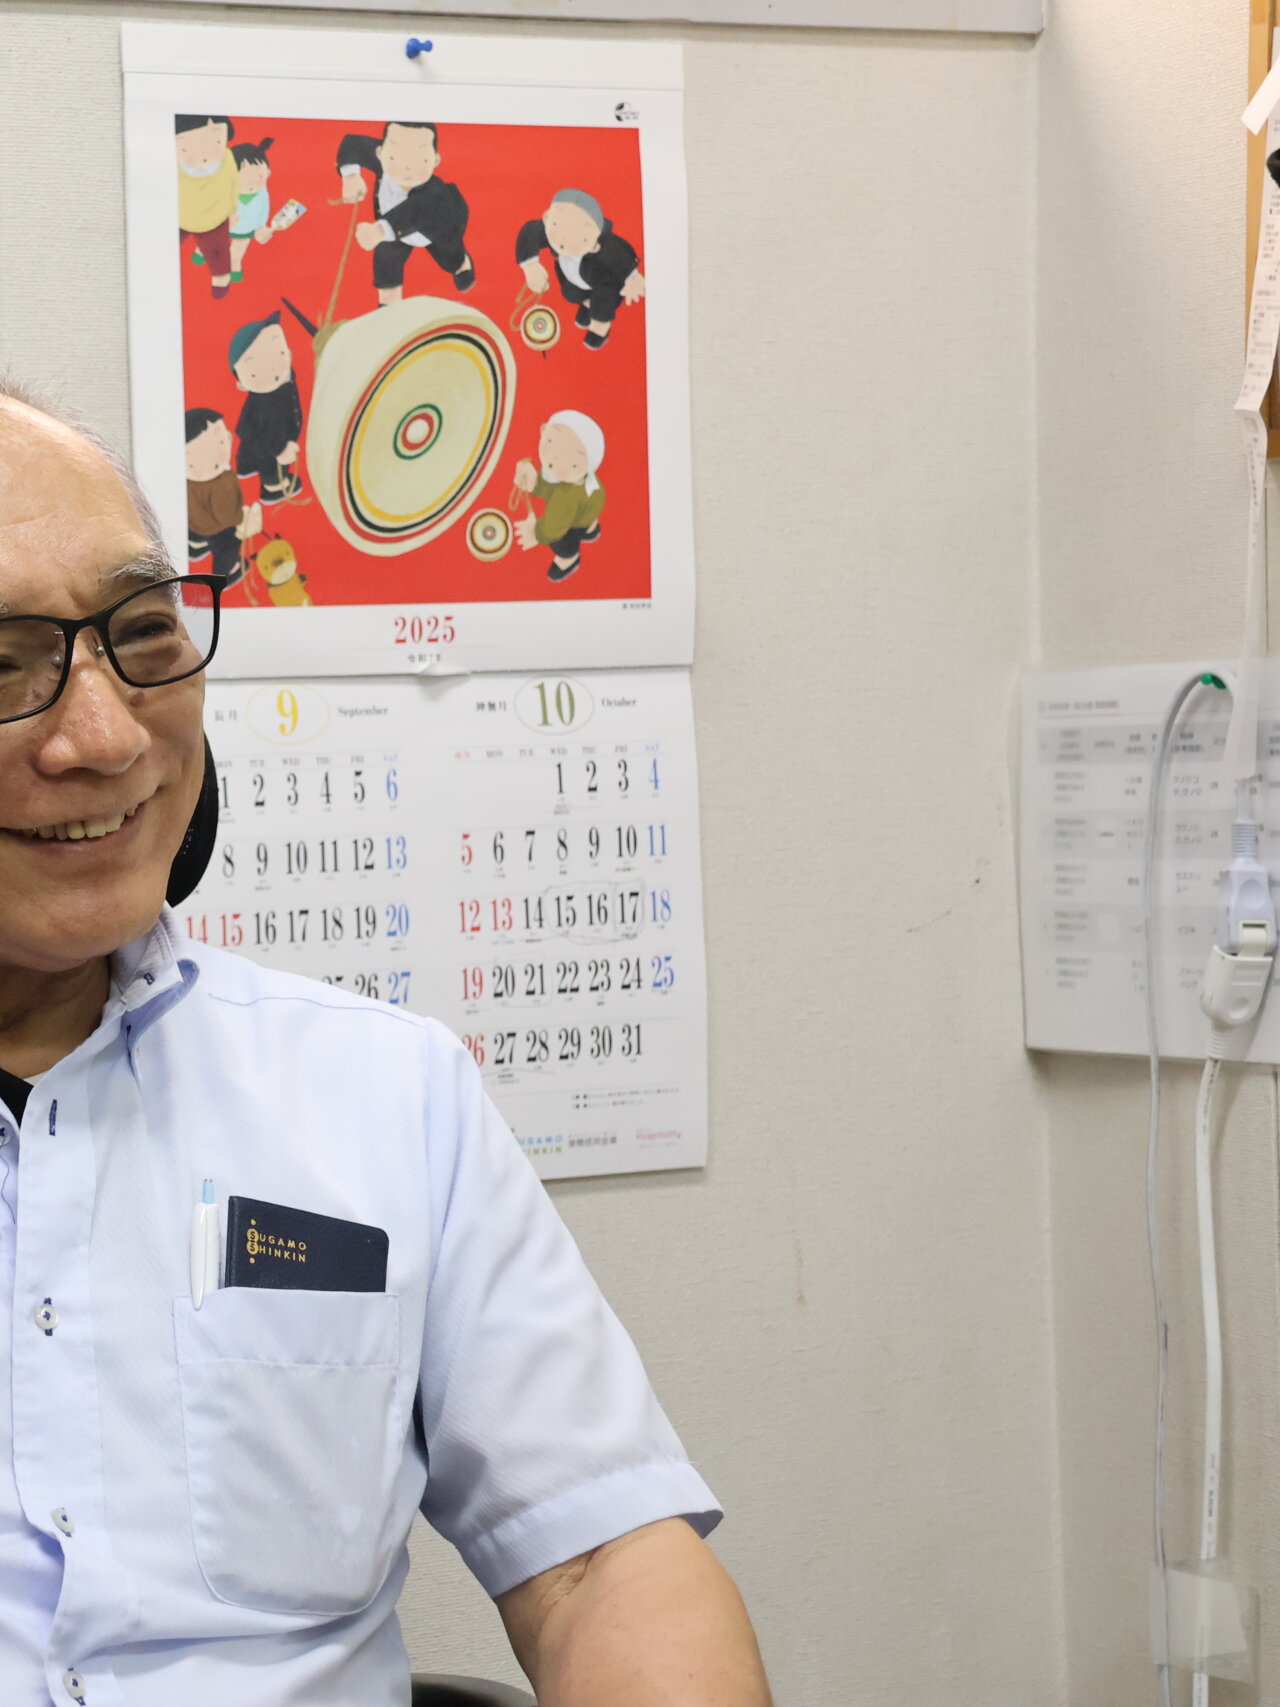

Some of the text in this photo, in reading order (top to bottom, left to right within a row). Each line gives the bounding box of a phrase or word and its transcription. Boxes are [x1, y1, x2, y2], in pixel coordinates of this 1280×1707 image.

[394, 615, 455, 644] 2025
[276, 689, 299, 737] 9
[337, 705, 388, 718] September
[534, 681, 576, 727] 10
[601, 697, 636, 708] October
[221, 768, 398, 808] 1 2 3 4 5 6
[556, 758, 660, 794] 1 2 3 4
[222, 835, 408, 878] 8 9 10 11 12 13
[461, 824, 667, 866] 5 6 7 8 9 10 11
[186, 904, 409, 947] 14 15 16 17 18 19 20
[459, 889, 672, 933] 12 13 14 15 16 17 18
[388, 971, 410, 1004] 27
[461, 955, 674, 1000] 19 20 21 22 23 24 25
[494, 1032, 516, 1064] 27
[526, 1030, 549, 1062] 28
[558, 1028, 581, 1060] 29
[590, 1026, 612, 1058] 30
[622, 1024, 642, 1056] 31
[517, 1135, 562, 1146] UGAMO
[249, 1230, 307, 1250] SUGAMO
[249, 1242, 306, 1263] SHINKIN
